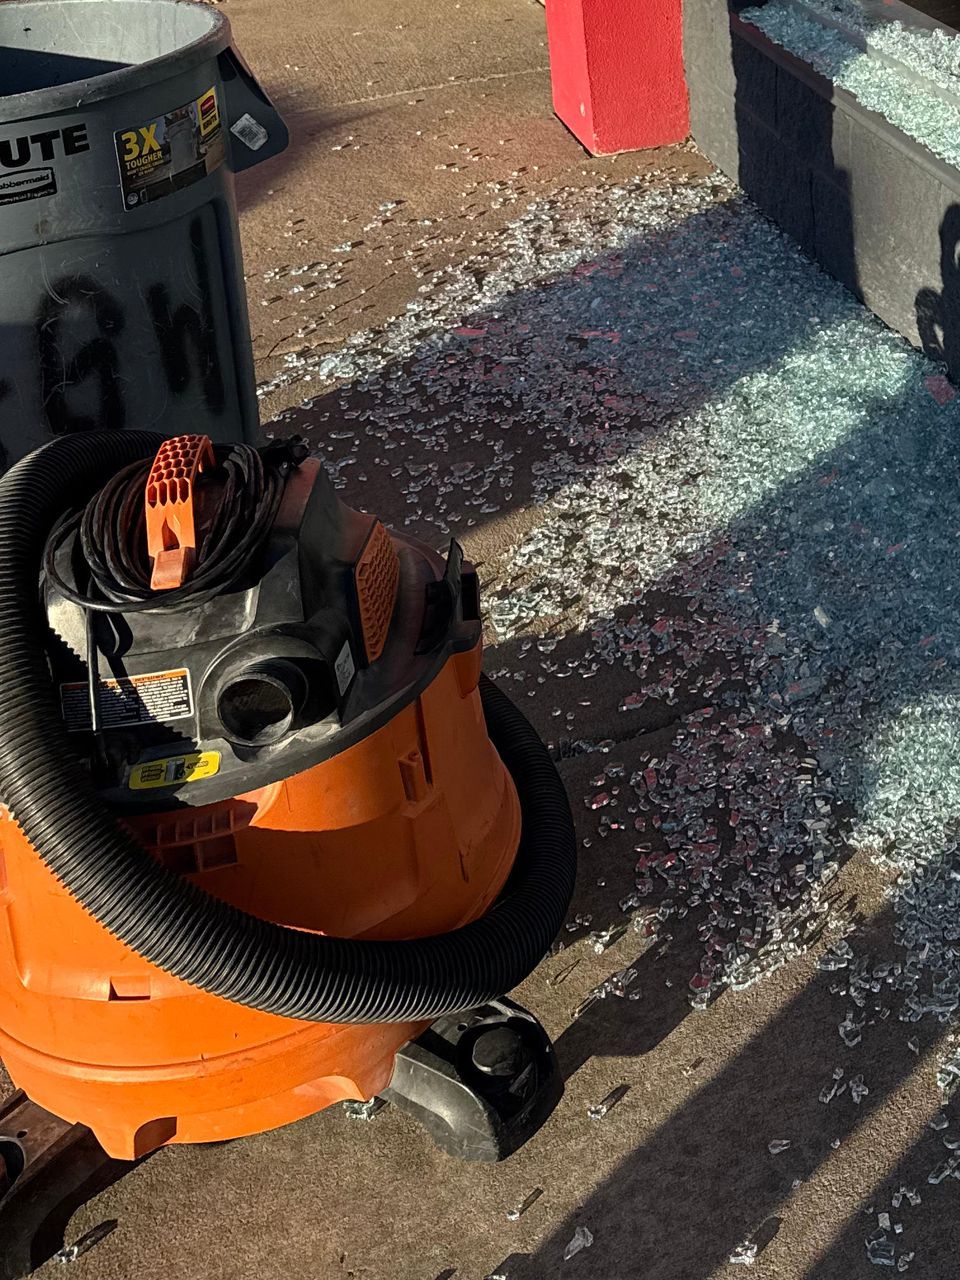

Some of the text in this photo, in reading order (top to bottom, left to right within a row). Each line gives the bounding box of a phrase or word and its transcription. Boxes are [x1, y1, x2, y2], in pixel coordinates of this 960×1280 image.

[0, 123, 90, 168] UTE
[121, 123, 161, 161] 3X
[125, 150, 163, 170] TOUGHER
